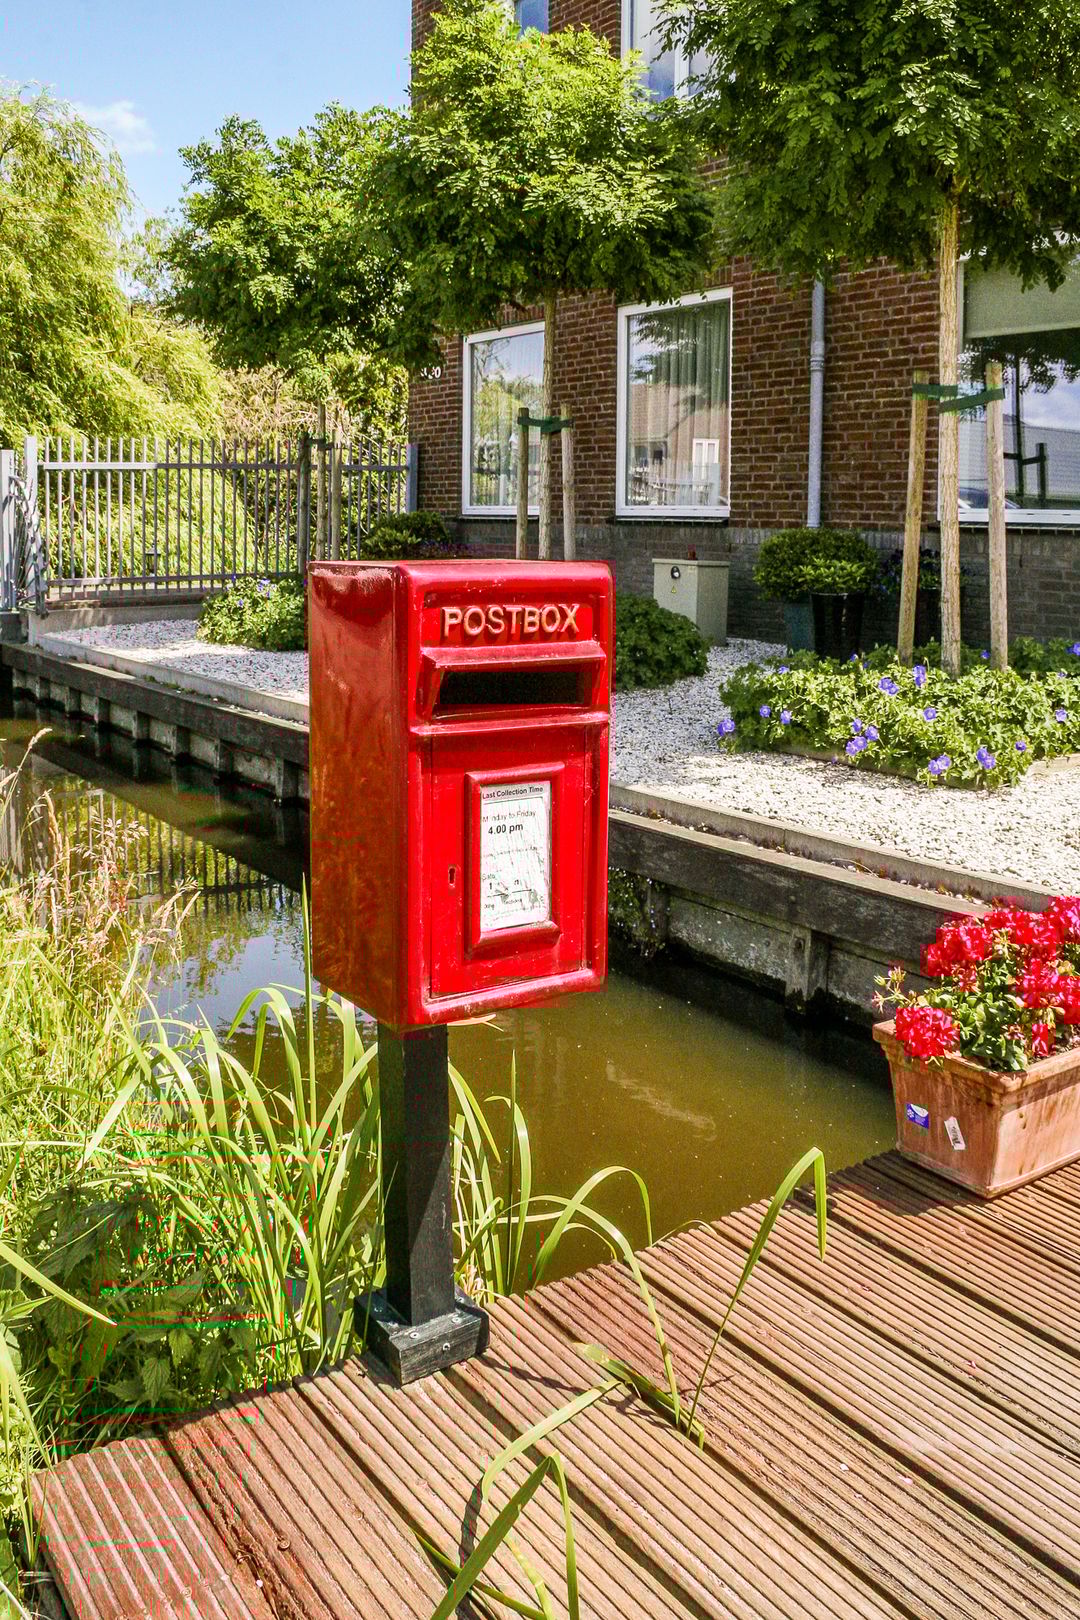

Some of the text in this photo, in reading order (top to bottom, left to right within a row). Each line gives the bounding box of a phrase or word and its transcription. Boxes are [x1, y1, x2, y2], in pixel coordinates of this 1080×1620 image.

[442, 604, 580, 637] POSTBOX
[496, 788, 527, 796] Collection
[516, 810, 536, 818] Friday
[488, 823, 523, 835] 4.00 pm
